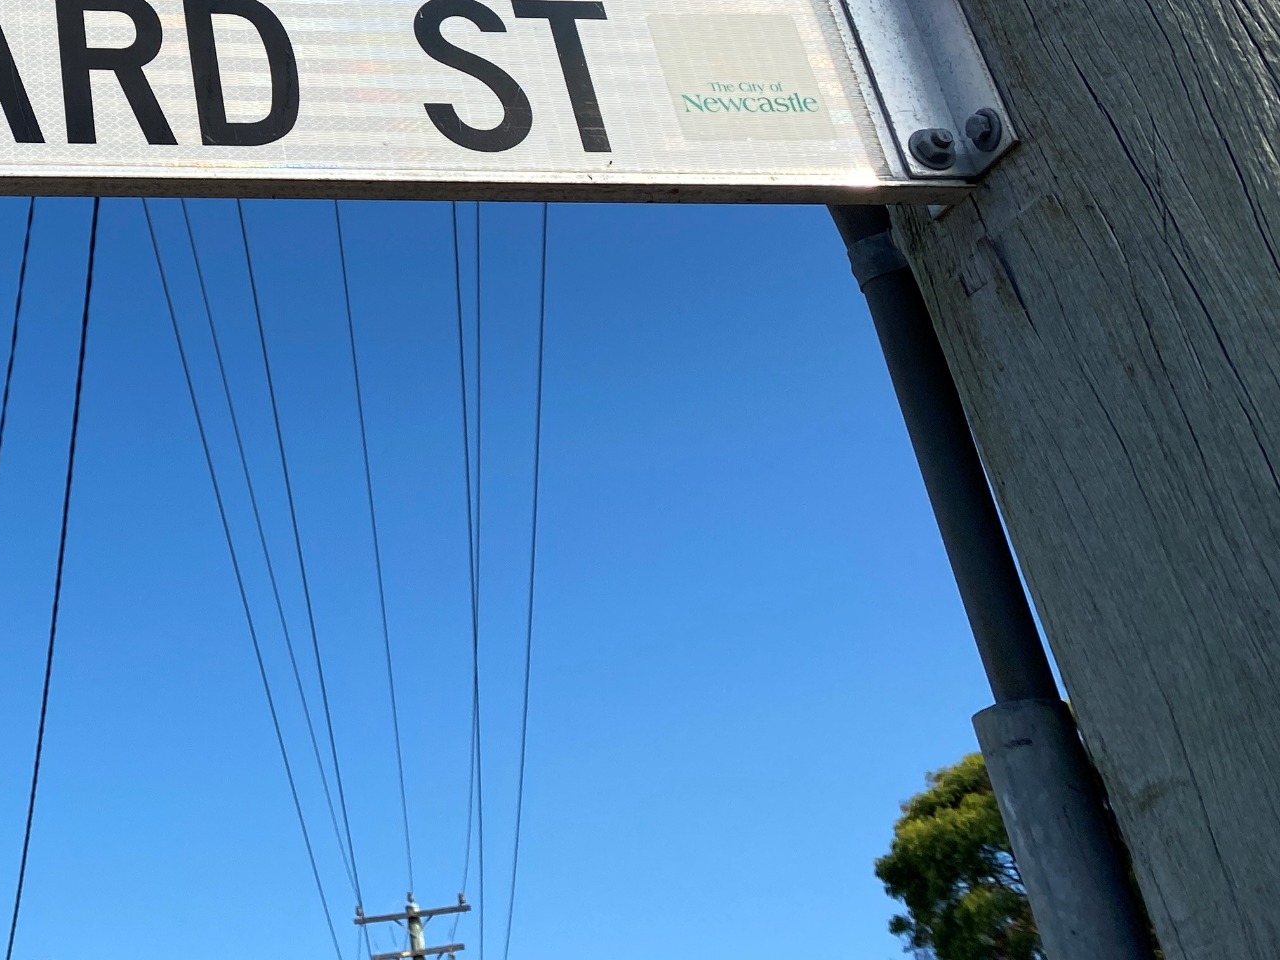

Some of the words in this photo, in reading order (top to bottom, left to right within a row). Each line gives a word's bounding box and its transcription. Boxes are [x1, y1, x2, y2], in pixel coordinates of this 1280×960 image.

[710, 82, 734, 92] The
[738, 81, 765, 95] City
[769, 81, 783, 92] of
[682, 93, 819, 112] Newcastle
